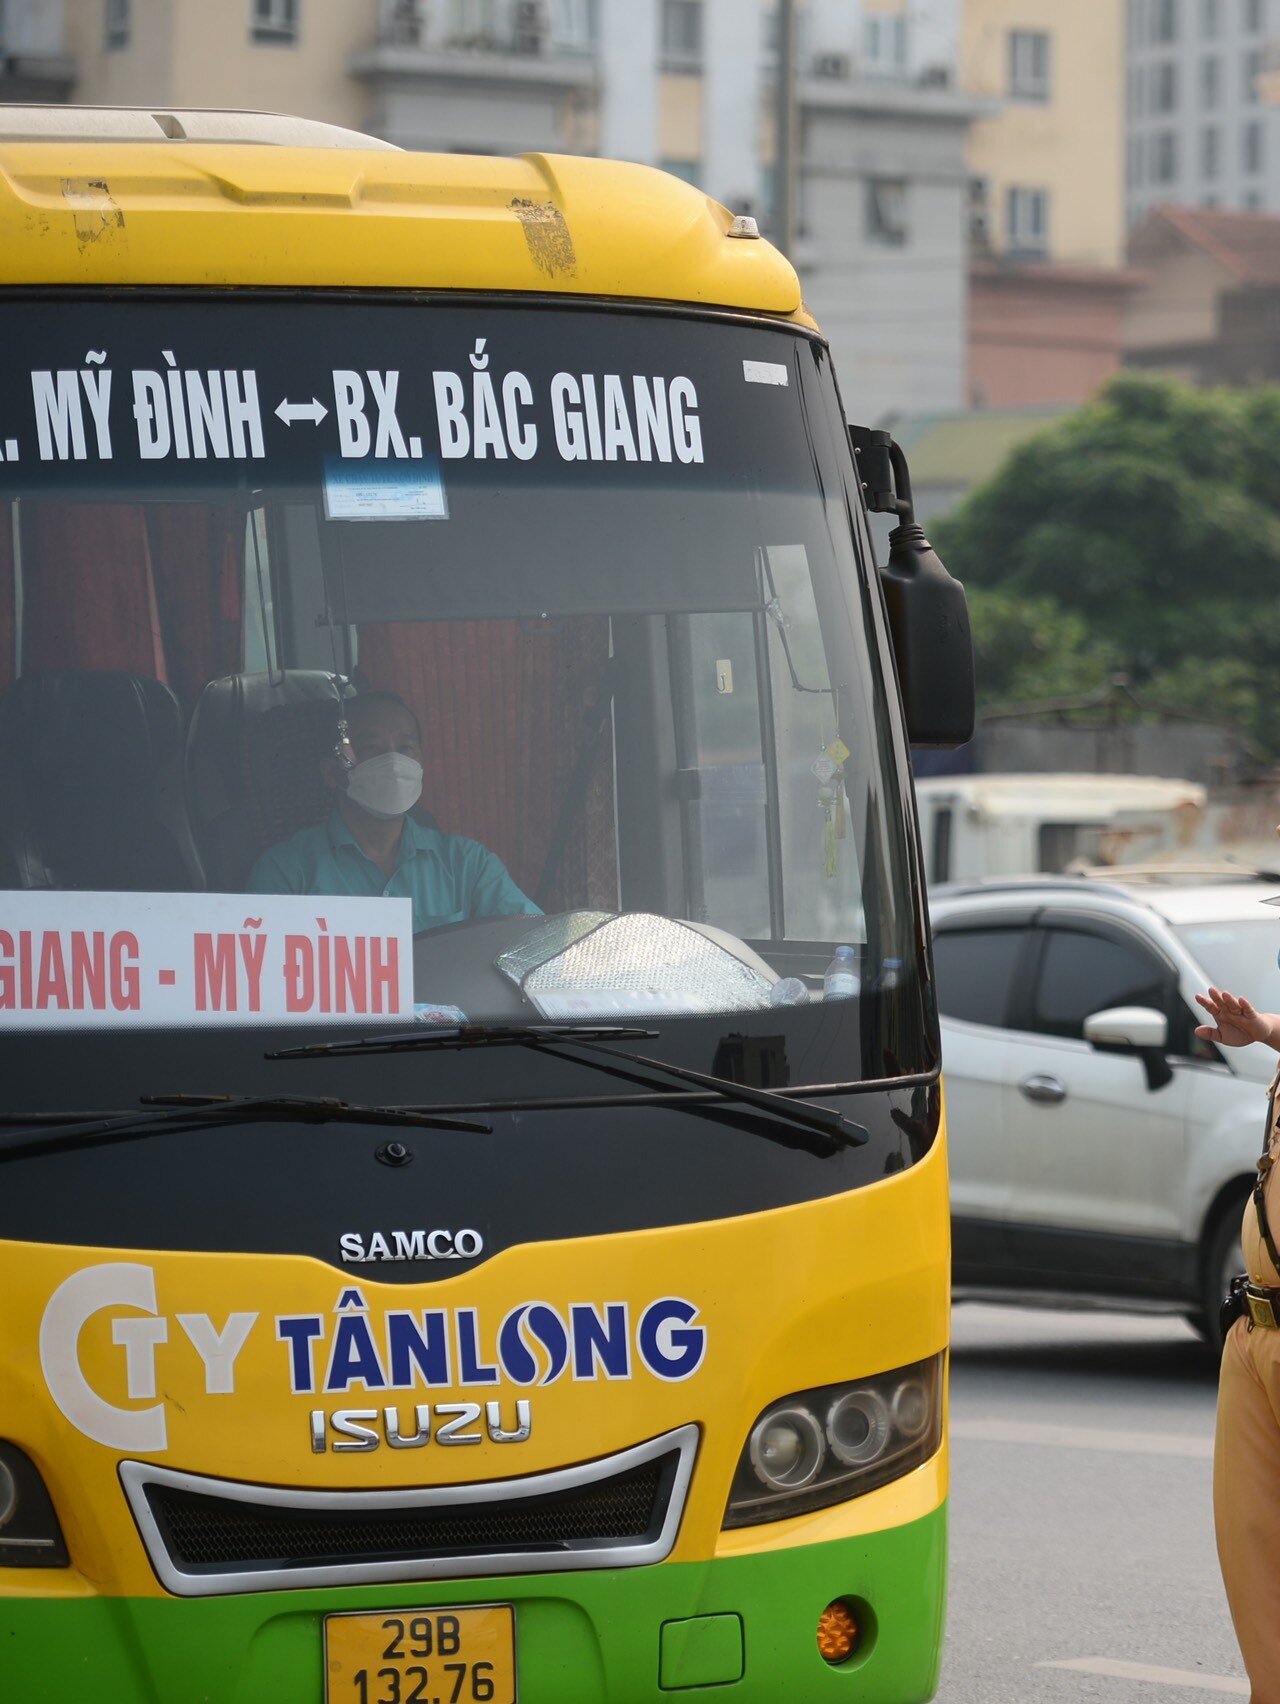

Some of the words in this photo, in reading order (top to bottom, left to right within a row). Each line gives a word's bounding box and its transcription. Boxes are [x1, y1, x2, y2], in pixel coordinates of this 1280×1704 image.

[31, 350, 112, 461] MỸ
[132, 350, 265, 459] ĐÌNH
[332, 370, 422, 459] BX.
[432, 338, 538, 461] BẮC
[550, 371, 704, 463] GIANG
[194, 917, 267, 1012] MỸ
[283, 918, 400, 1014] ĐÌNH
[340, 1229, 484, 1262] SAMCO
[309, 1400, 531, 1453] ISUZU
[382, 1615, 461, 1660] 29B
[353, 1661, 495, 1704] 132.76
